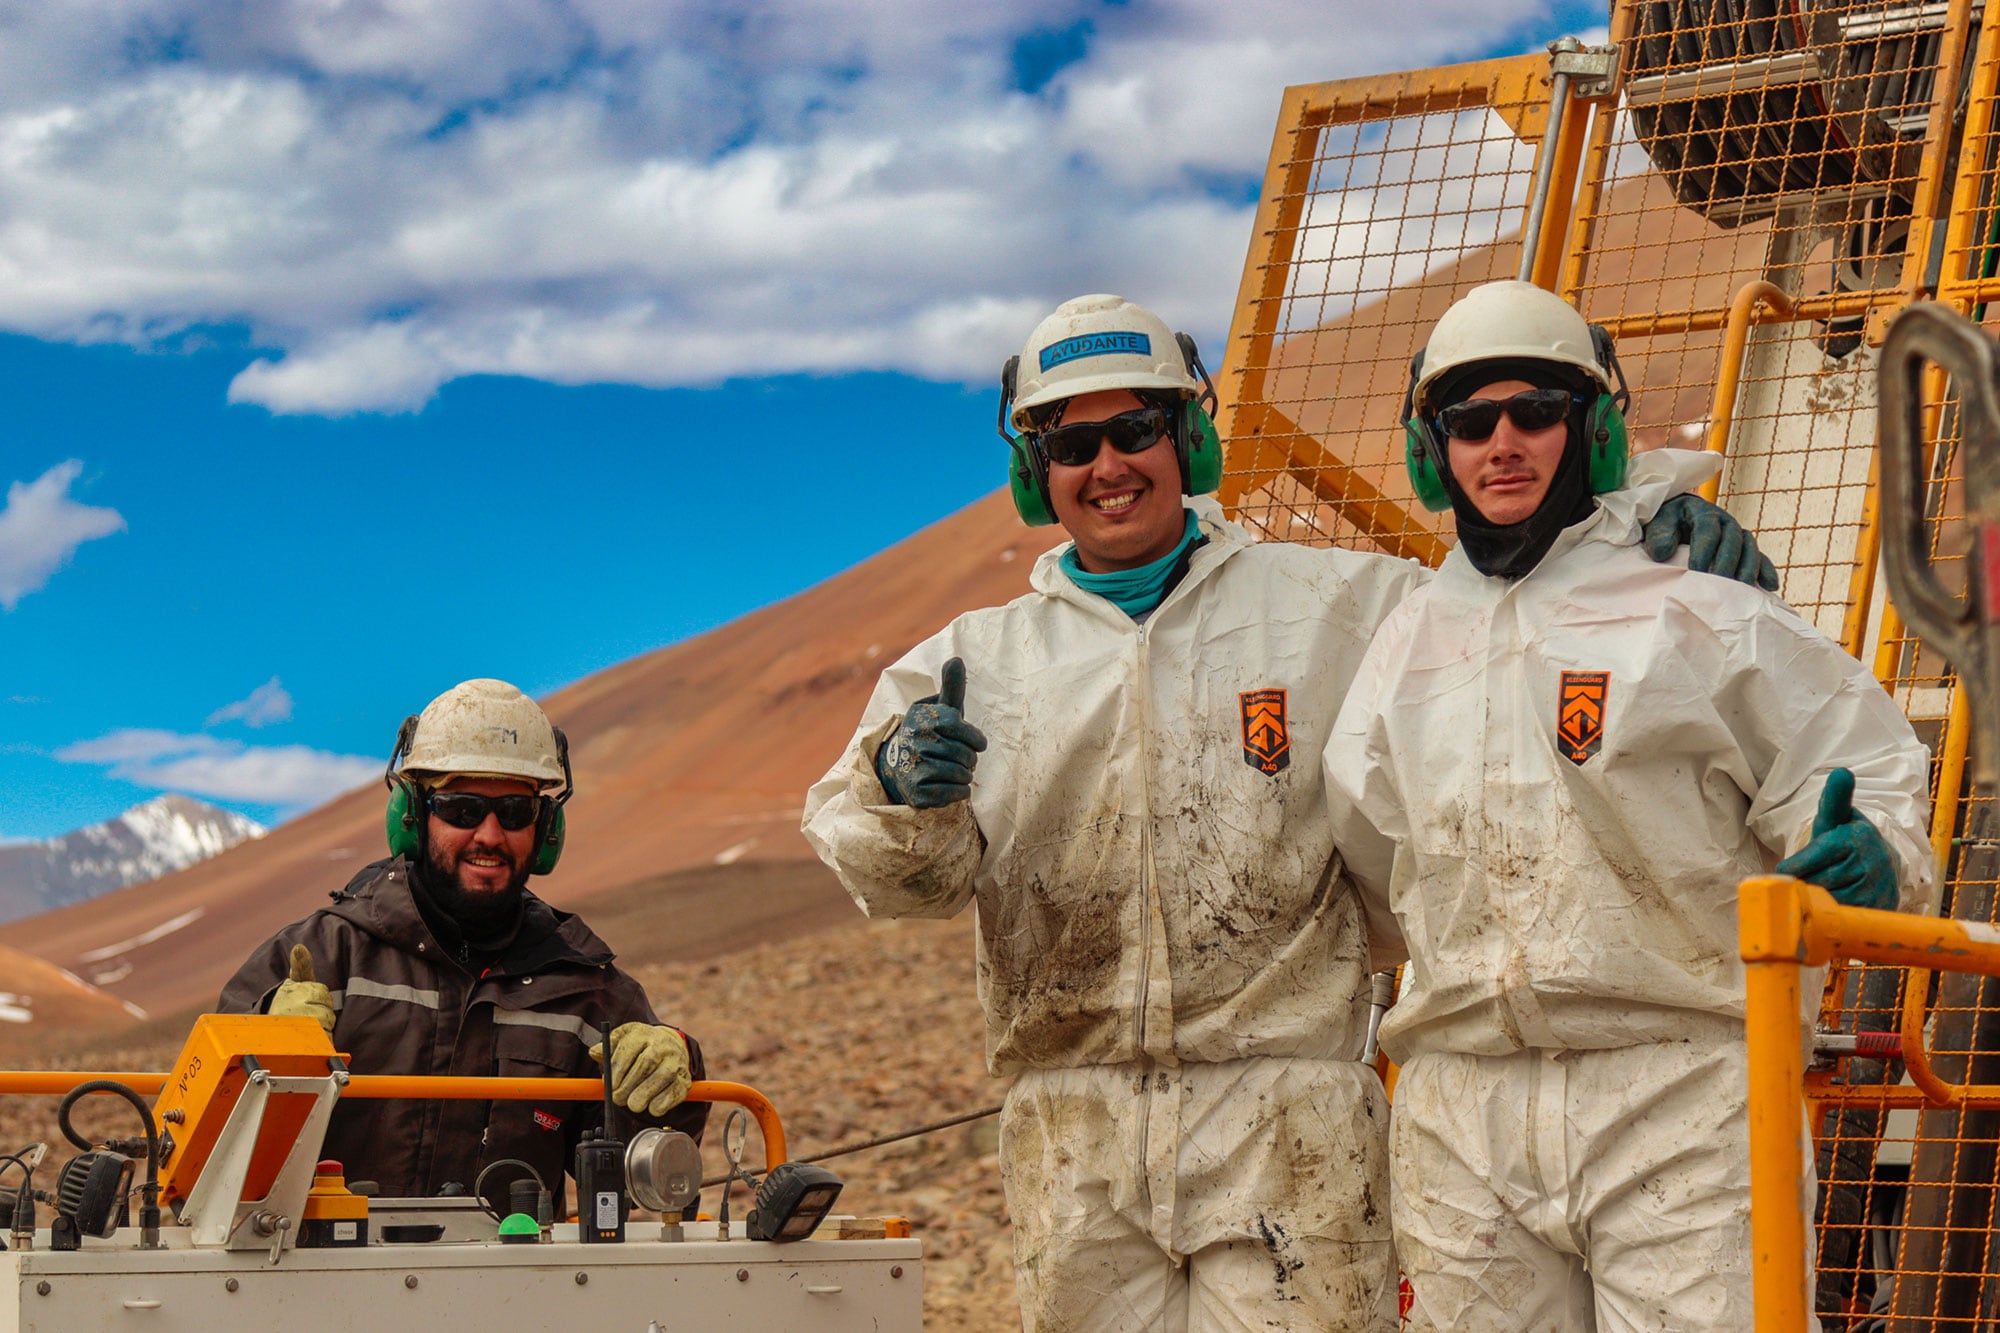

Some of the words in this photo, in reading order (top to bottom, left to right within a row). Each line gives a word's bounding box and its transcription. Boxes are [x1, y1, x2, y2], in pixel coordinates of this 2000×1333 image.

[1050, 335, 1138, 362] AYUDANTE
[1571, 751, 1588, 760] A40
[1261, 763, 1278, 771] A40
[189, 1056, 202, 1078] 03
